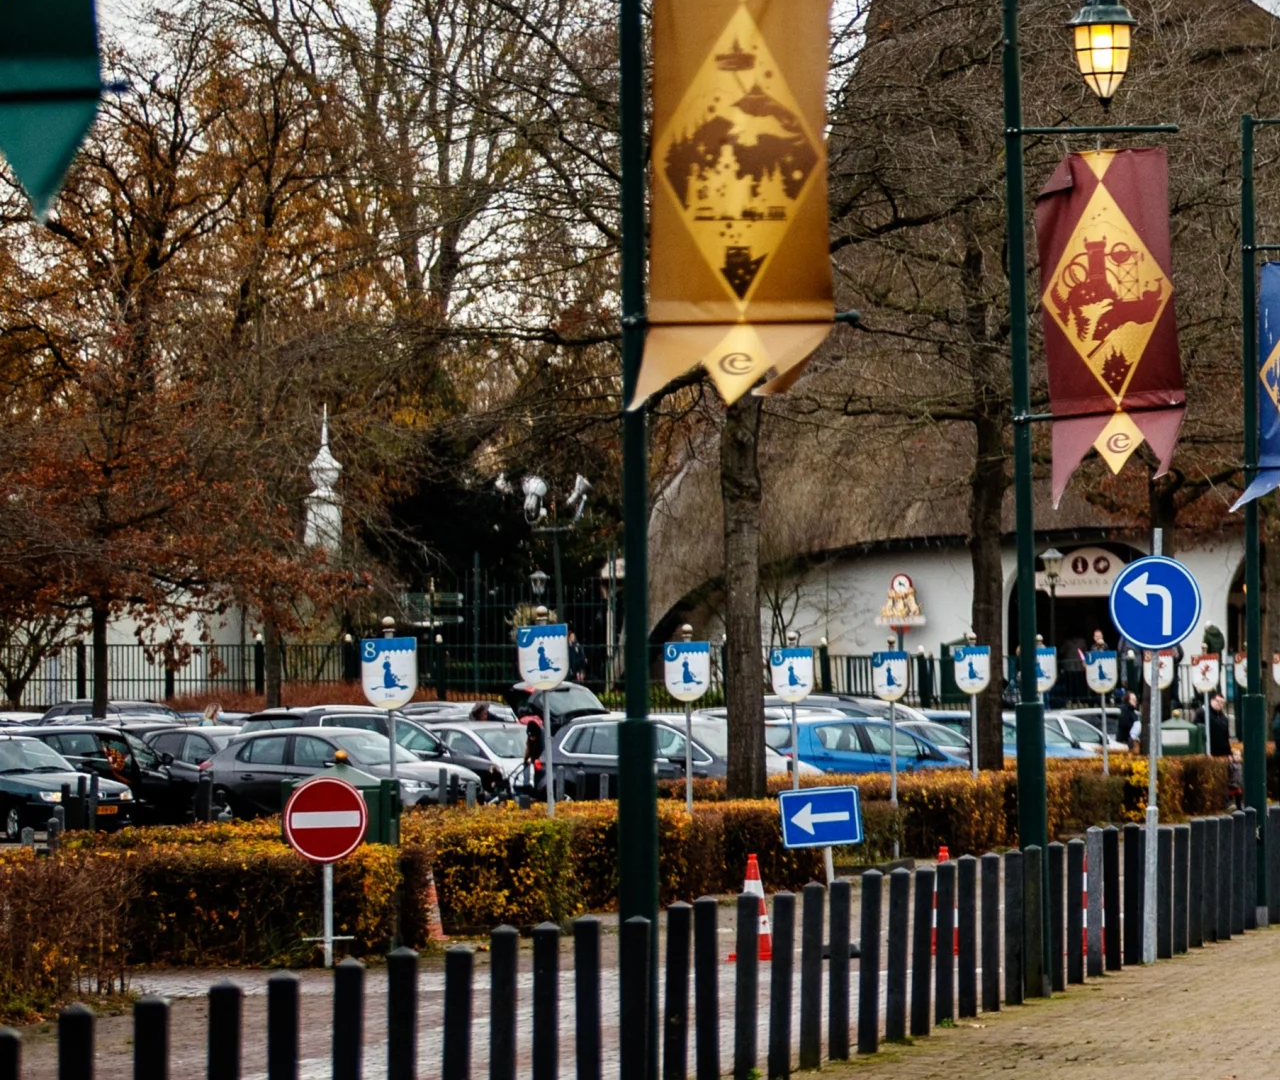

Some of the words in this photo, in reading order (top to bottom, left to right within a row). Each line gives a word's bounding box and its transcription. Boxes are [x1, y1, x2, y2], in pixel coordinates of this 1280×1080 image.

[520, 628, 532, 643] 7
[364, 641, 377, 658] 8
[666, 644, 678, 659] 6
[774, 650, 783, 664] 5
